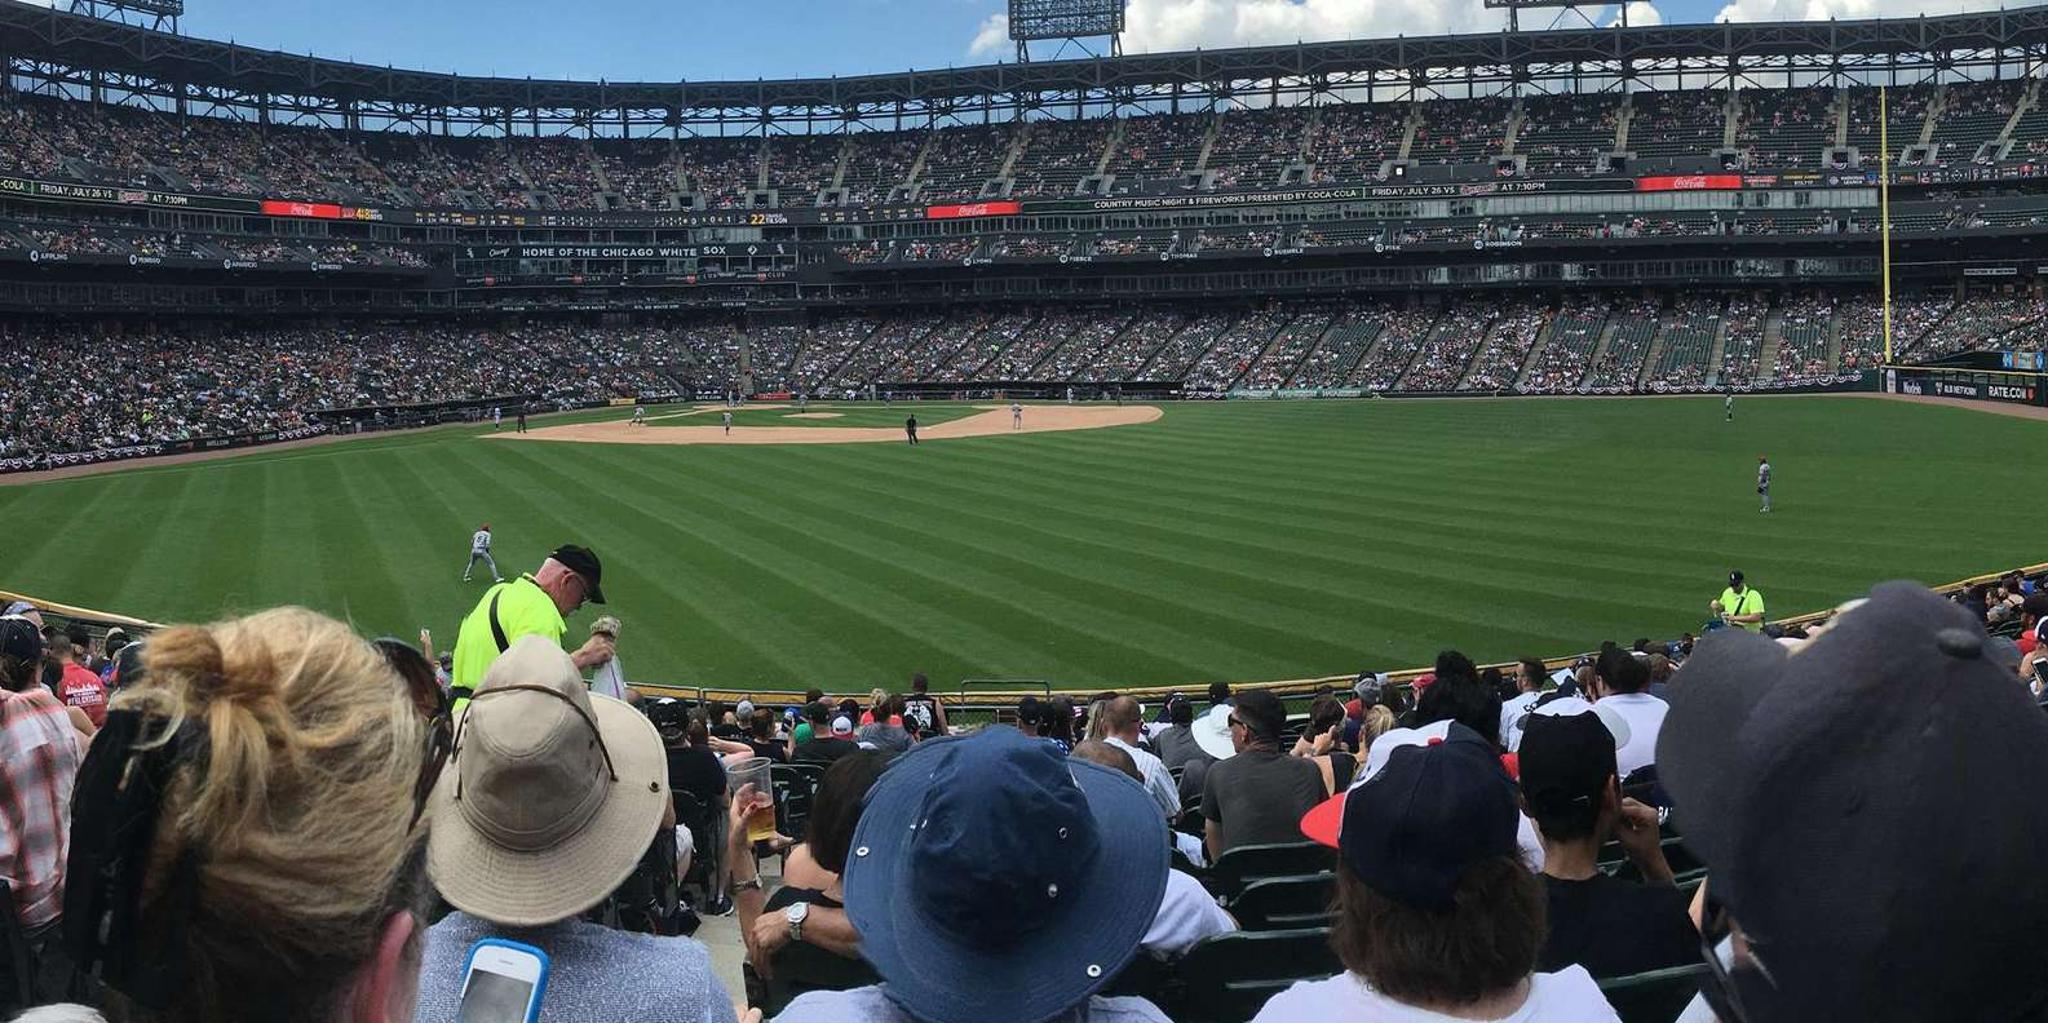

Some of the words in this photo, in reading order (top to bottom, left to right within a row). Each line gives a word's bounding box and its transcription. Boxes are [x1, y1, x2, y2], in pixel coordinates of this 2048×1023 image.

[41, 184, 70, 196] FRIDAY,
[72, 187, 91, 197] JULY
[152, 195, 163, 203] AT
[1372, 188, 1406, 196] FRIDAY,
[1408, 187, 1428, 195] JULY
[1444, 186, 1455, 194] VS
[1094, 200, 1132, 209] COUNTRY
[1135, 200, 1161, 208] MUSIC
[1162, 199, 1186, 207] NIGHT
[1196, 196, 1245, 205] FIREWORKS
[1247, 192, 1294, 202] PRESENTED
[1296, 192, 1307, 200] BY
[1308, 190, 1356, 199] COCA-COLA
[750, 214, 766, 224] 22
[522, 248, 554, 257] HOME
[559, 248, 573, 257] OF
[576, 248, 598, 257] THE
[602, 248, 654, 257] CHICAGO
[660, 248, 697, 257] WHITE
[704, 246, 726, 255] SOX
